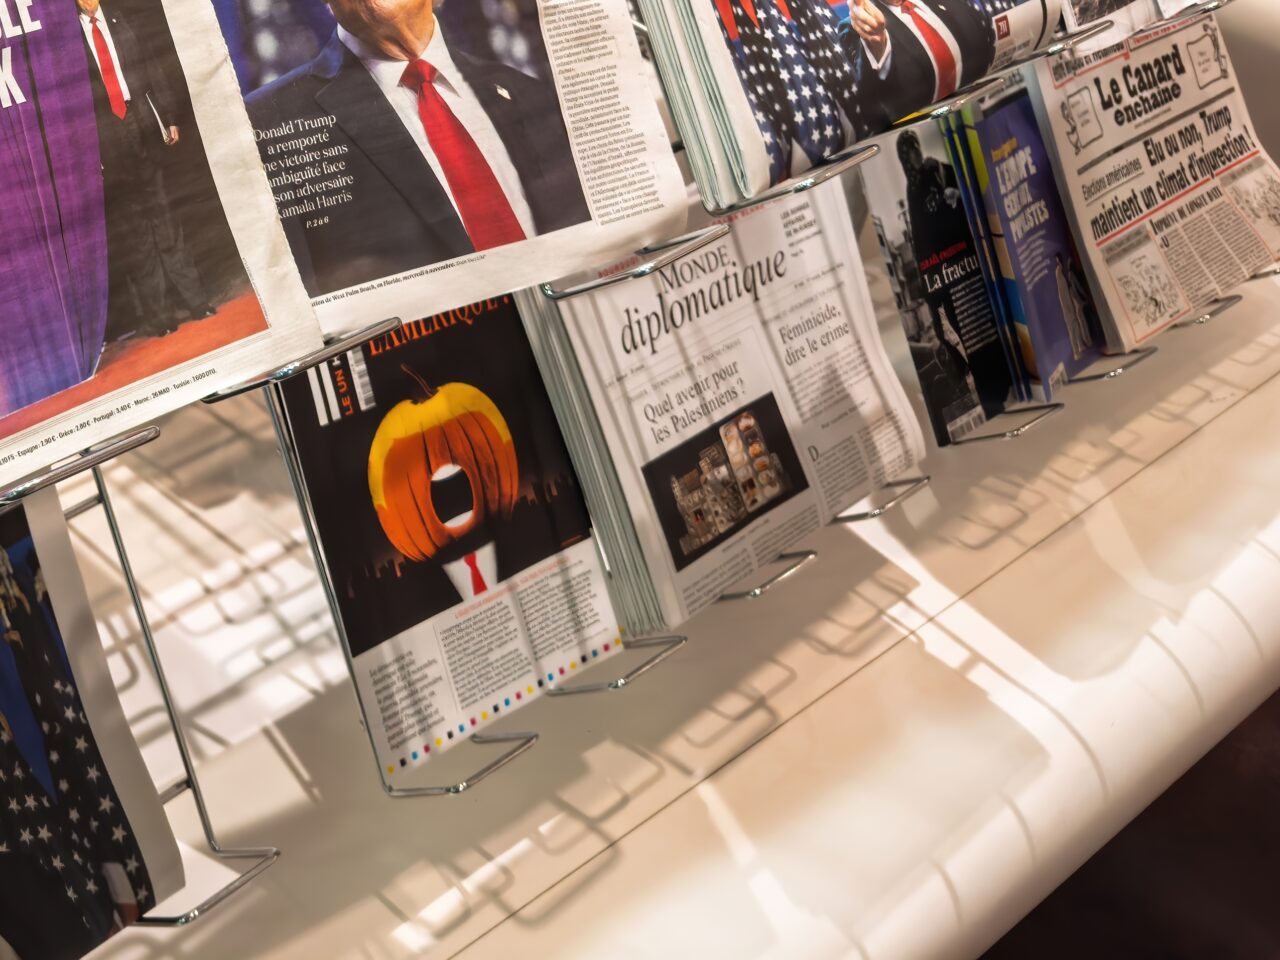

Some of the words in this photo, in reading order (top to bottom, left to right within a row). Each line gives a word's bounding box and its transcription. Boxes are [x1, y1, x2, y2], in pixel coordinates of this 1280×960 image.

[1093, 76, 1122, 111] Le
[1122, 43, 1186, 96] Canard
[1114, 81, 1182, 127] enchaîné
[253, 123, 295, 142] Donald
[290, 114, 336, 132] Trump
[267, 145, 275, 154] a
[275, 128, 329, 152] remporté
[1143, 139, 1165, 166] Elu
[1163, 133, 1180, 157] ou
[1177, 122, 1203, 149] non,
[1199, 105, 1231, 136] Trump
[278, 150, 320, 167] victoire
[322, 144, 348, 157] sans
[322, 161, 345, 174] face
[296, 174, 353, 197] adversaire
[315, 189, 352, 208] Harris
[1090, 192, 1143, 240] maintient
[1139, 185, 1158, 210] un
[1155, 165, 1190, 200] climat
[656, 245, 730, 296] MONDE
[620, 250, 788, 356] diplomatique
[778, 303, 840, 344] Féminicide,
[784, 345, 806, 366] dire
[805, 337, 818, 353] le
[819, 322, 848, 347] crime
[335, 369, 347, 392] UN
[643, 393, 674, 424] Quel
[675, 376, 710, 405] avenir
[711, 361, 738, 390] pour
[341, 394, 354, 417] LE
[650, 425, 671, 444] les
[669, 386, 738, 433] Palestiniens
